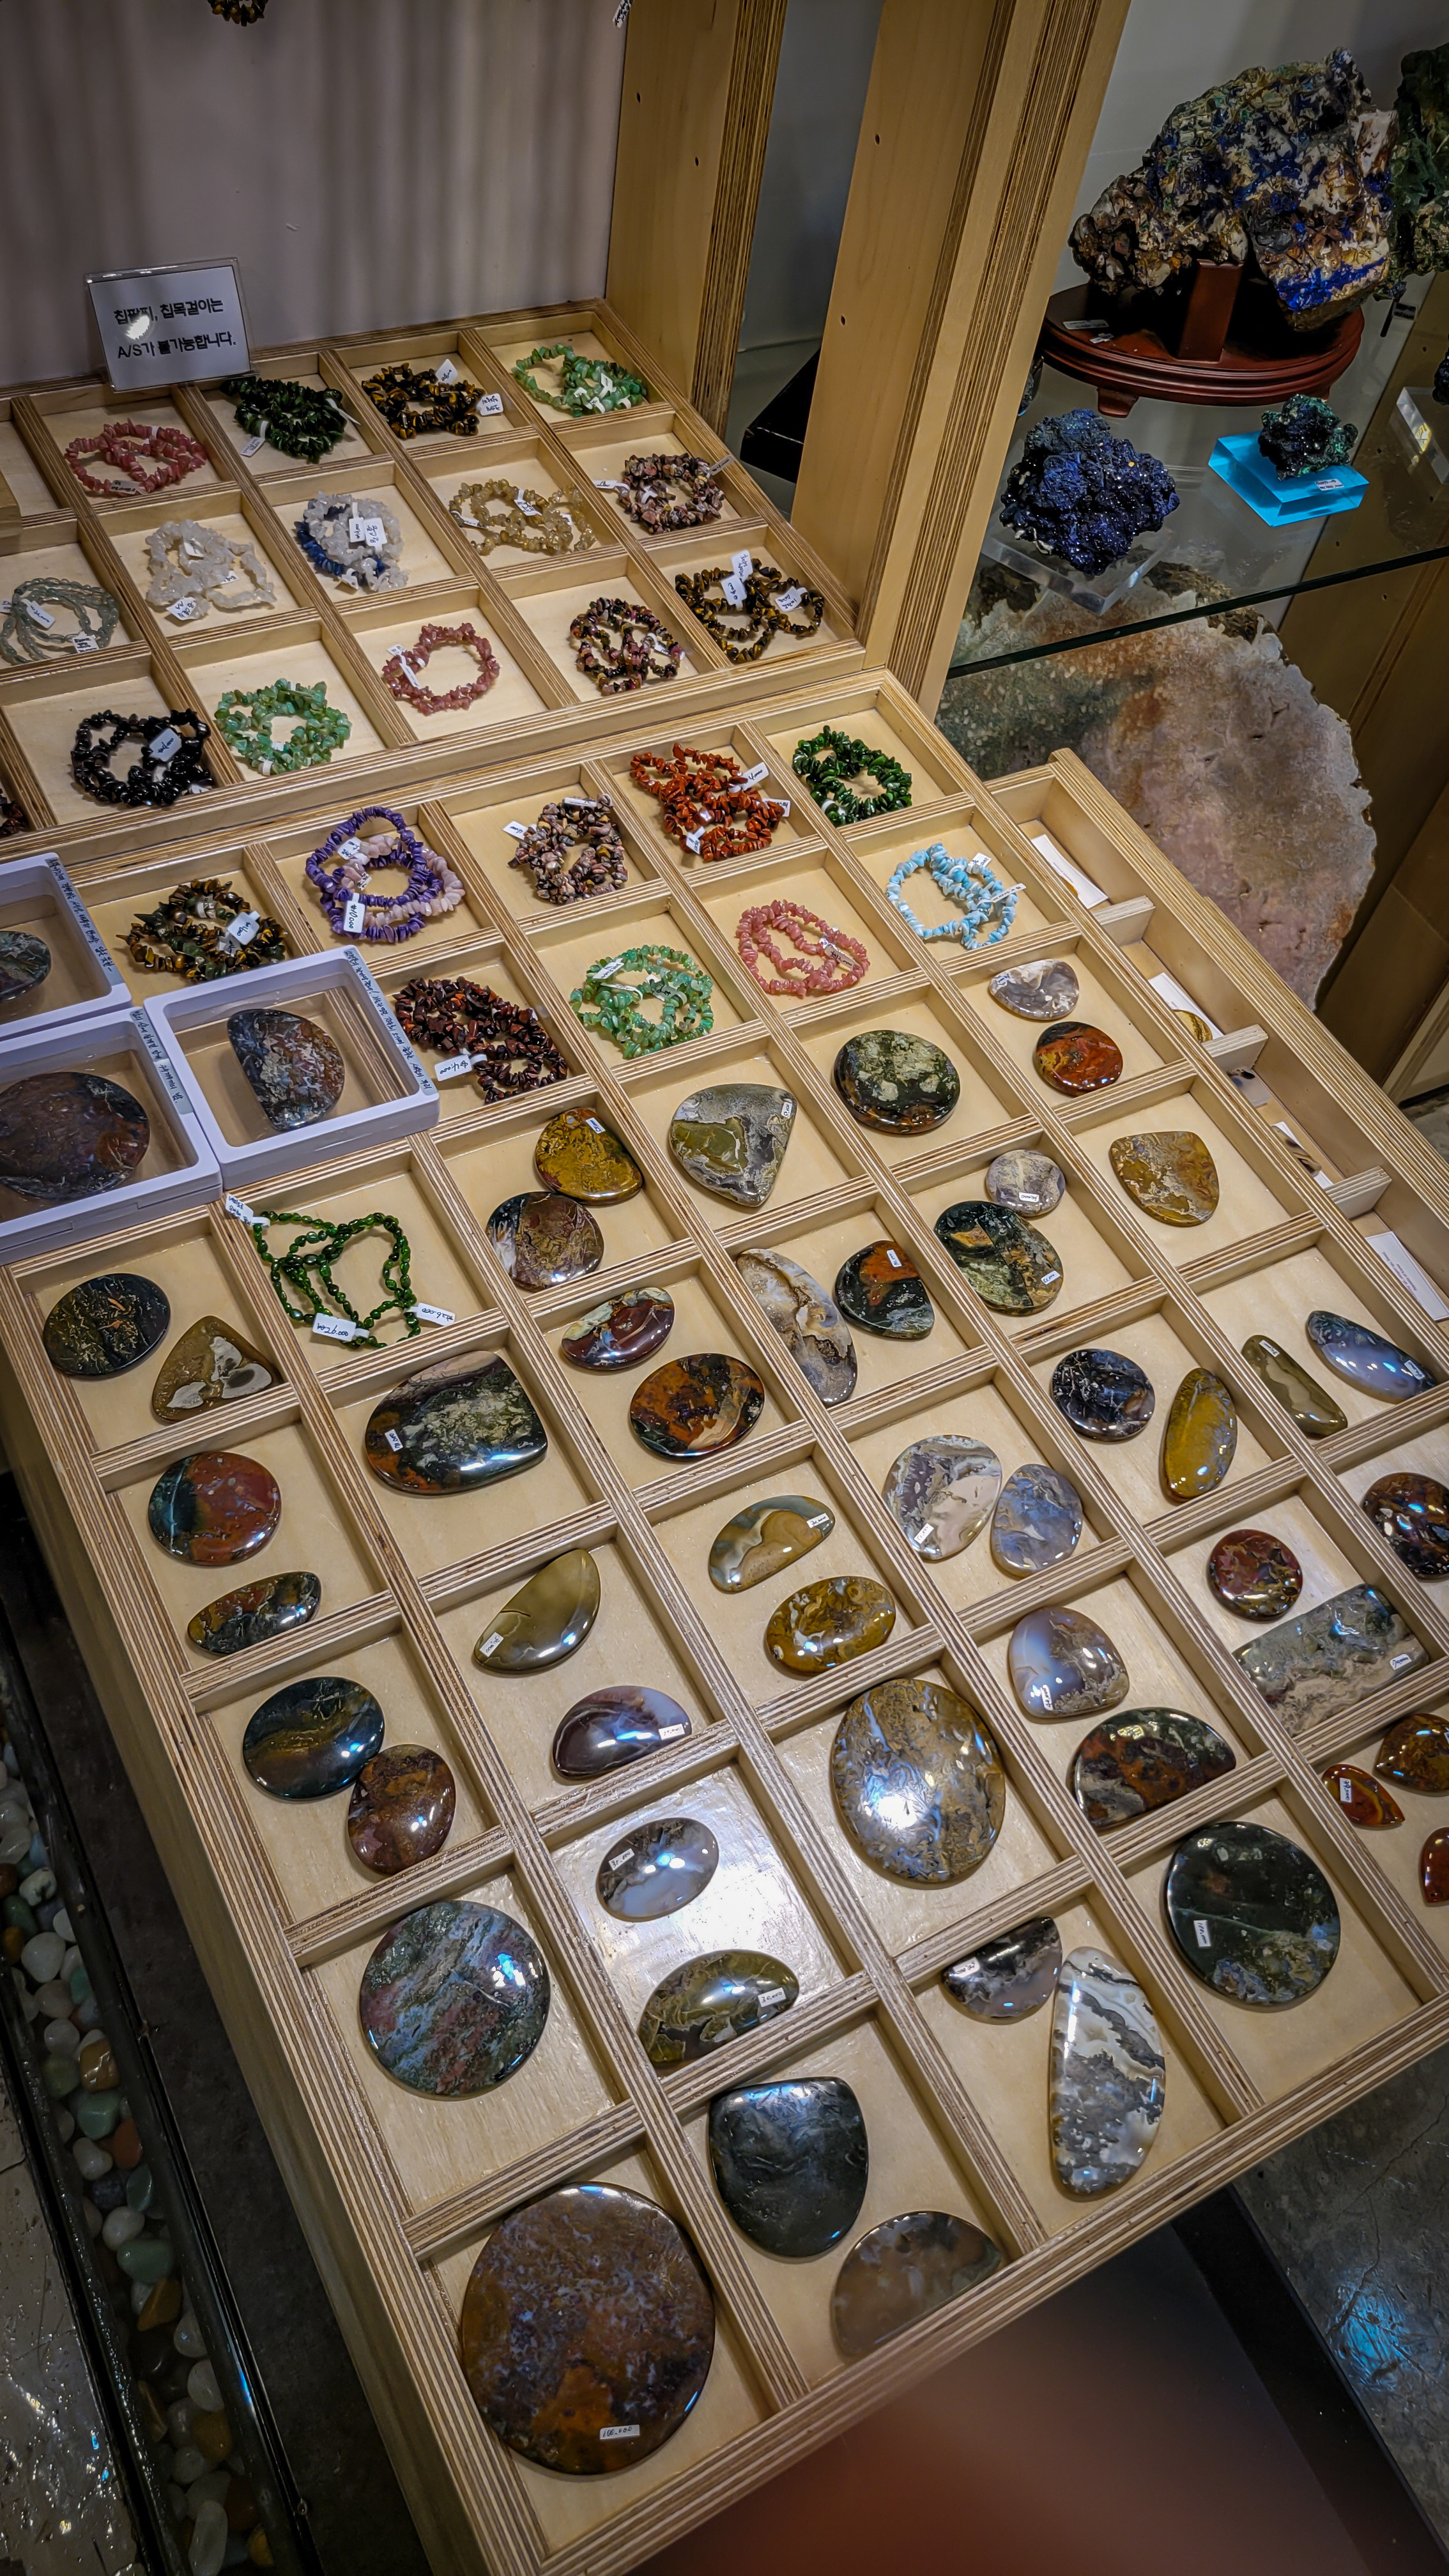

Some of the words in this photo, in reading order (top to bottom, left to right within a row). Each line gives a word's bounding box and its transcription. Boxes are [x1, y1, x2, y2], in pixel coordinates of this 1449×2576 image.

[160, 298, 224, 319] 칩목걸이는
[118, 342, 156, 358] A/S가
[158, 331, 236, 355] 불가능합니다.
